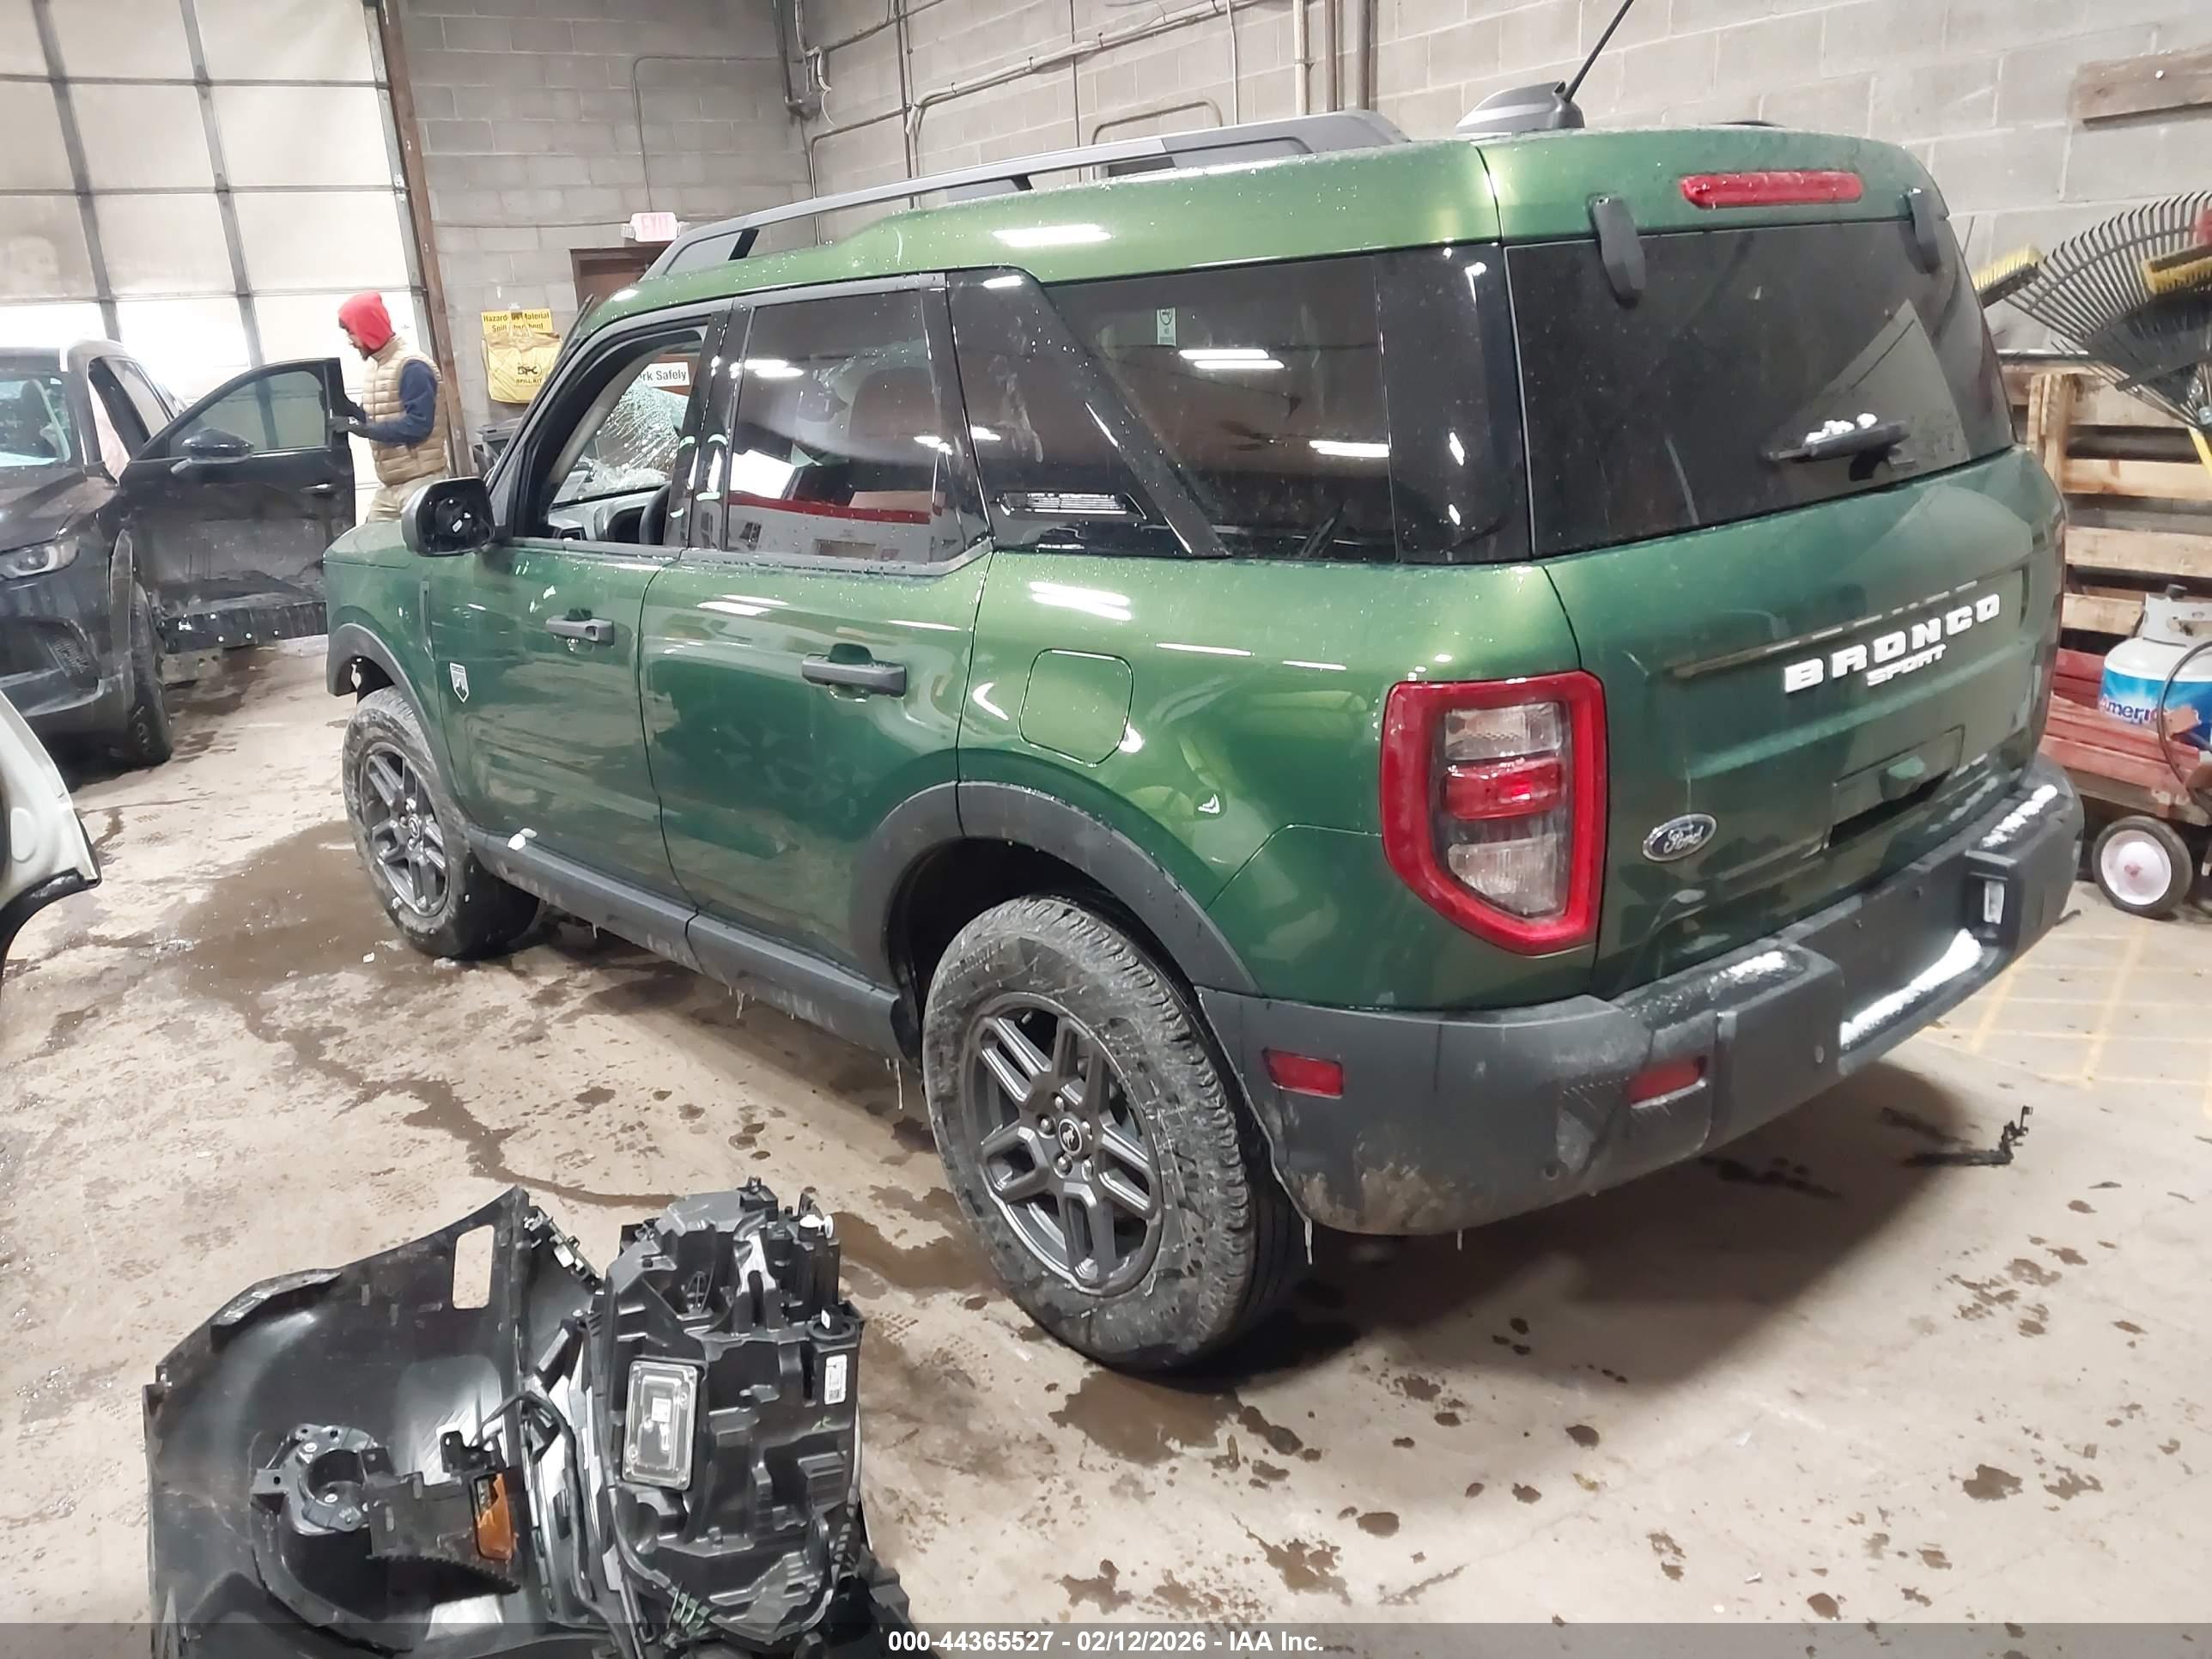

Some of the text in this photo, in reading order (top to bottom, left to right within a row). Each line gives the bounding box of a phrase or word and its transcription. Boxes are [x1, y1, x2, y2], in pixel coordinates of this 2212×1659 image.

[641, 214, 670, 234] EXIT
[655, 369, 687, 381] Safely
[1784, 593, 2001, 694] BRONCO
[1866, 643, 1948, 686] SPORT
